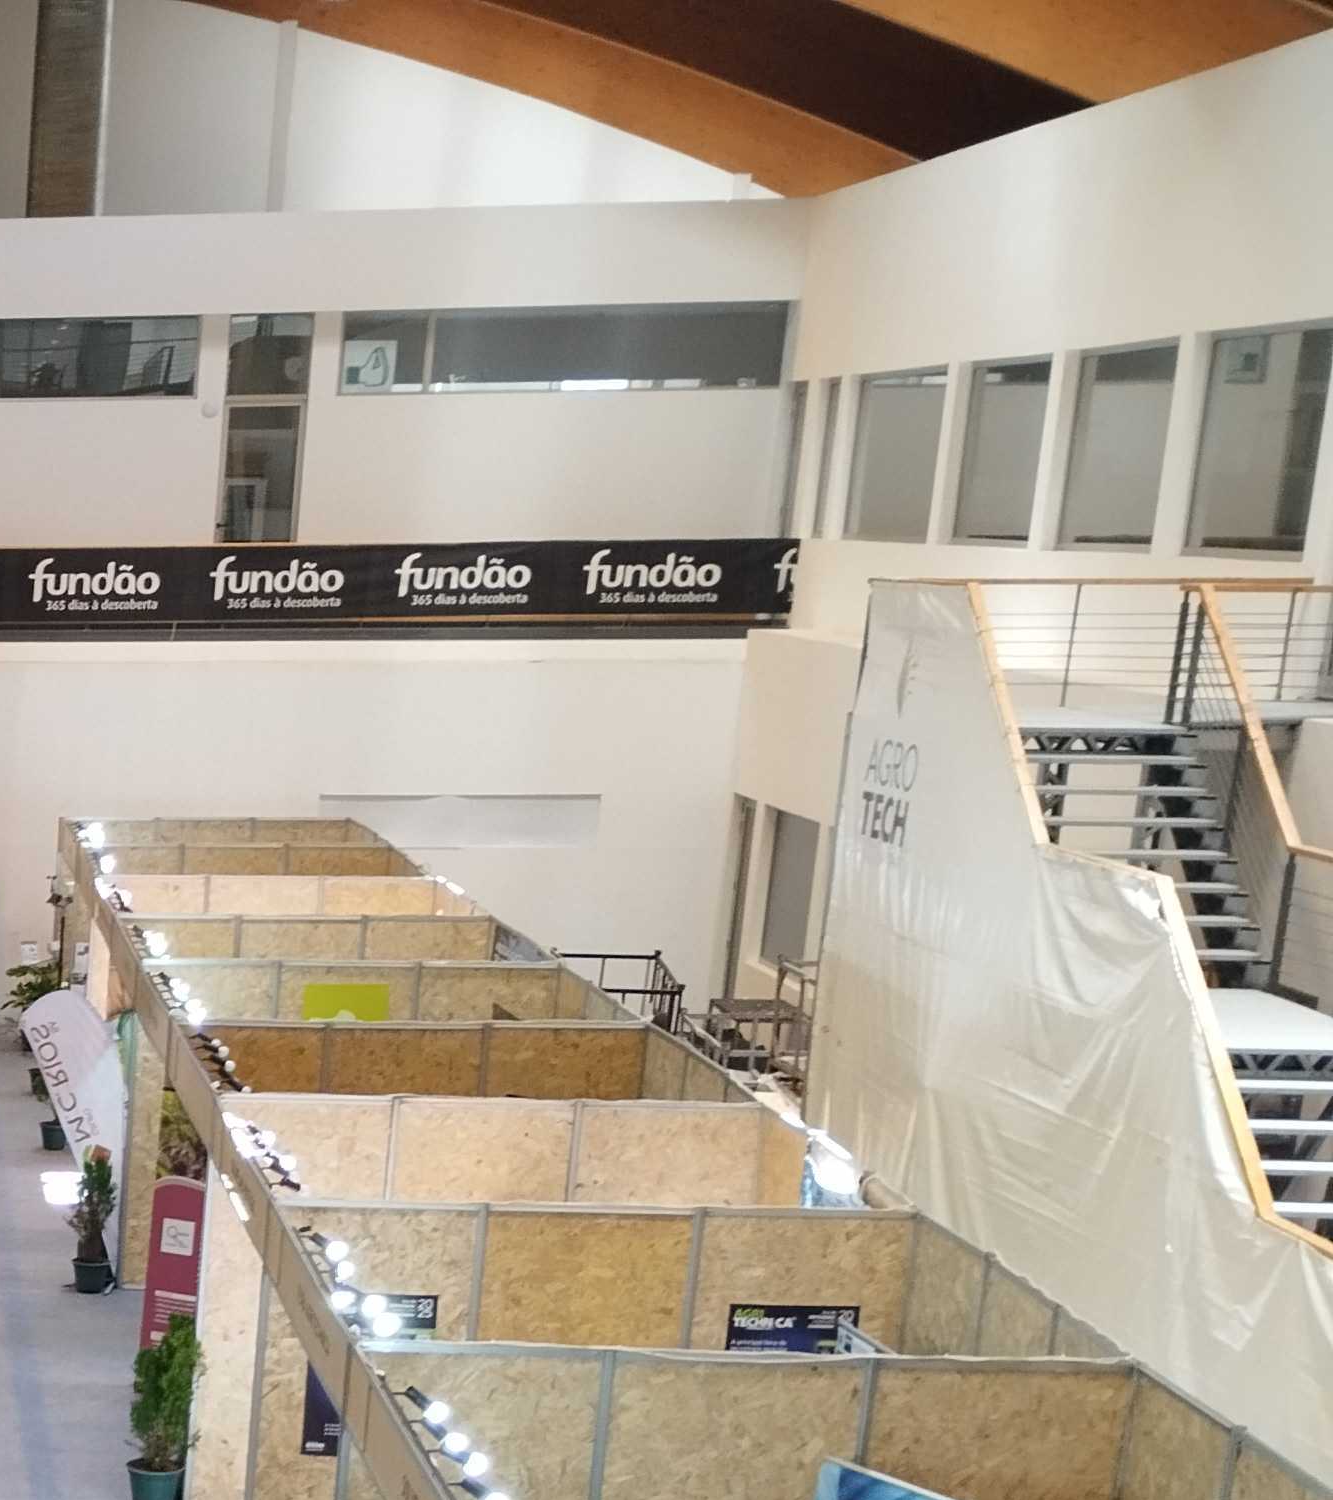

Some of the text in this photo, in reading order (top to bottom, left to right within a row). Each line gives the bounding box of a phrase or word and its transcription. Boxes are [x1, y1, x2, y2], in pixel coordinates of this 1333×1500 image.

[28, 556, 161, 602] fundão
[209, 554, 344, 600] fundão
[394, 552, 532, 596] fundão
[583, 548, 722, 595] fundão
[46, 598, 65, 611] 365
[68, 598, 90, 612] dias
[101, 598, 159, 612] descoberta
[863, 737, 919, 792] AGRO
[861, 791, 910, 848] TECH
